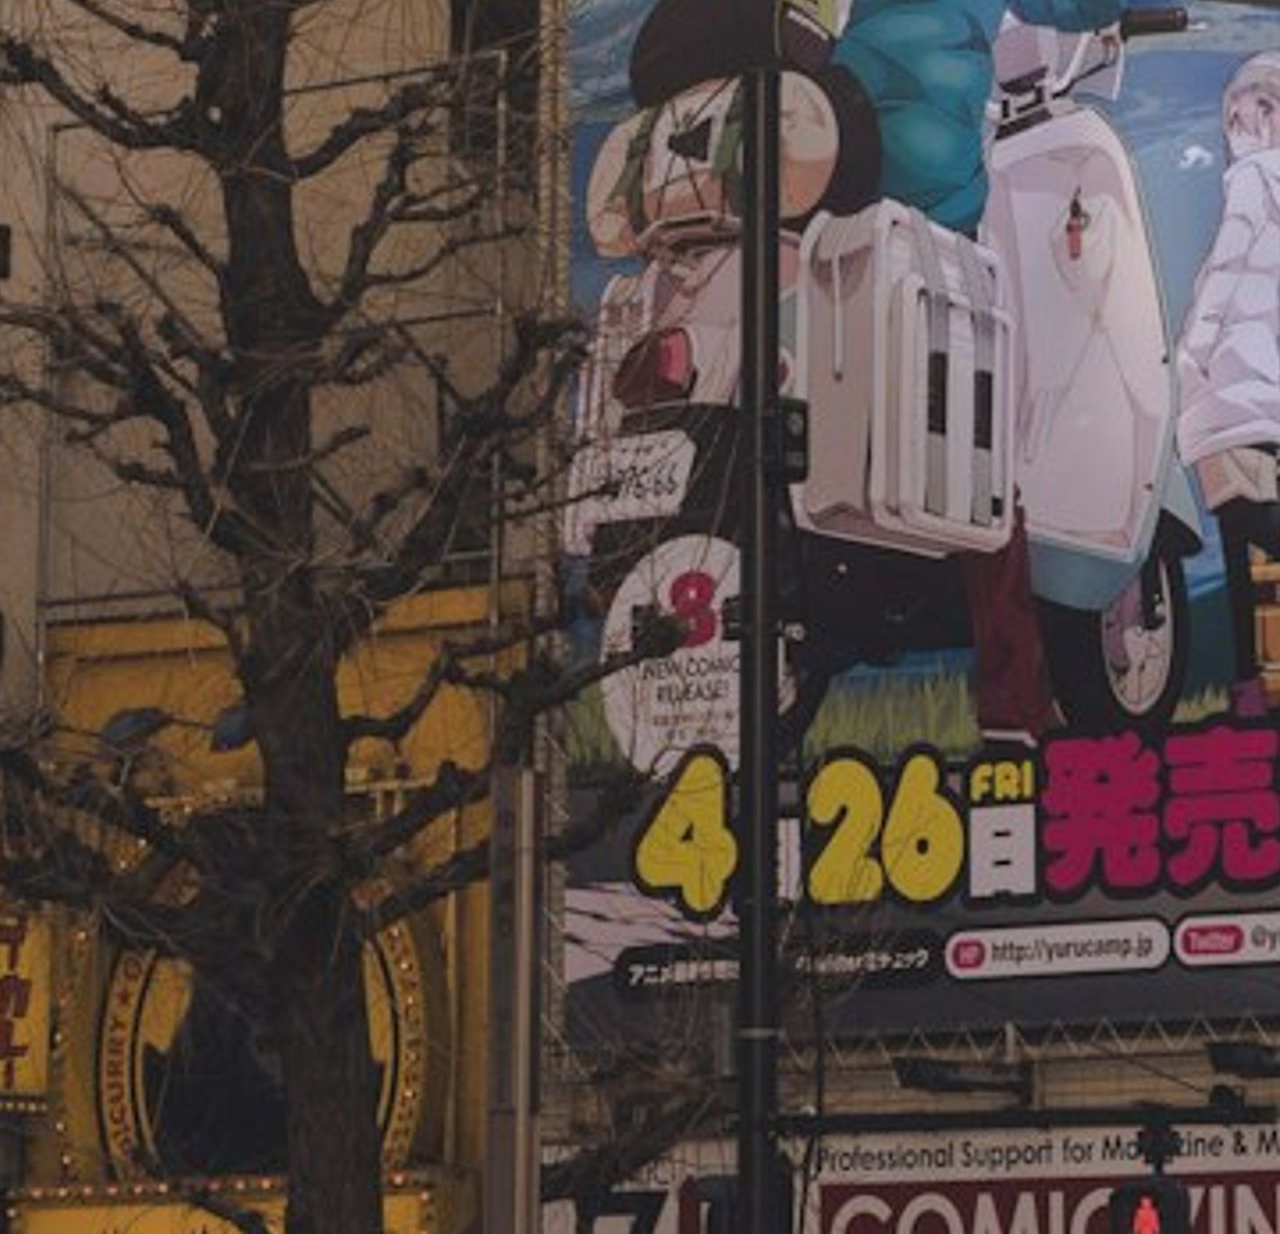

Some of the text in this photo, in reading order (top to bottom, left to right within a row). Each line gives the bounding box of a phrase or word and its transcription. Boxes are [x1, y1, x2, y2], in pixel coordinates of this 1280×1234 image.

[970, 759, 1035, 802] FRI
[990, 936, 1154, 966] http://yurucamp.jp
[820, 1141, 955, 1174] Professional
[962, 1134, 1054, 1174] Support
[1062, 1131, 1095, 1160] for
[1100, 1126, 1225, 1162] Mazine
[1231, 1130, 1250, 1157] &
